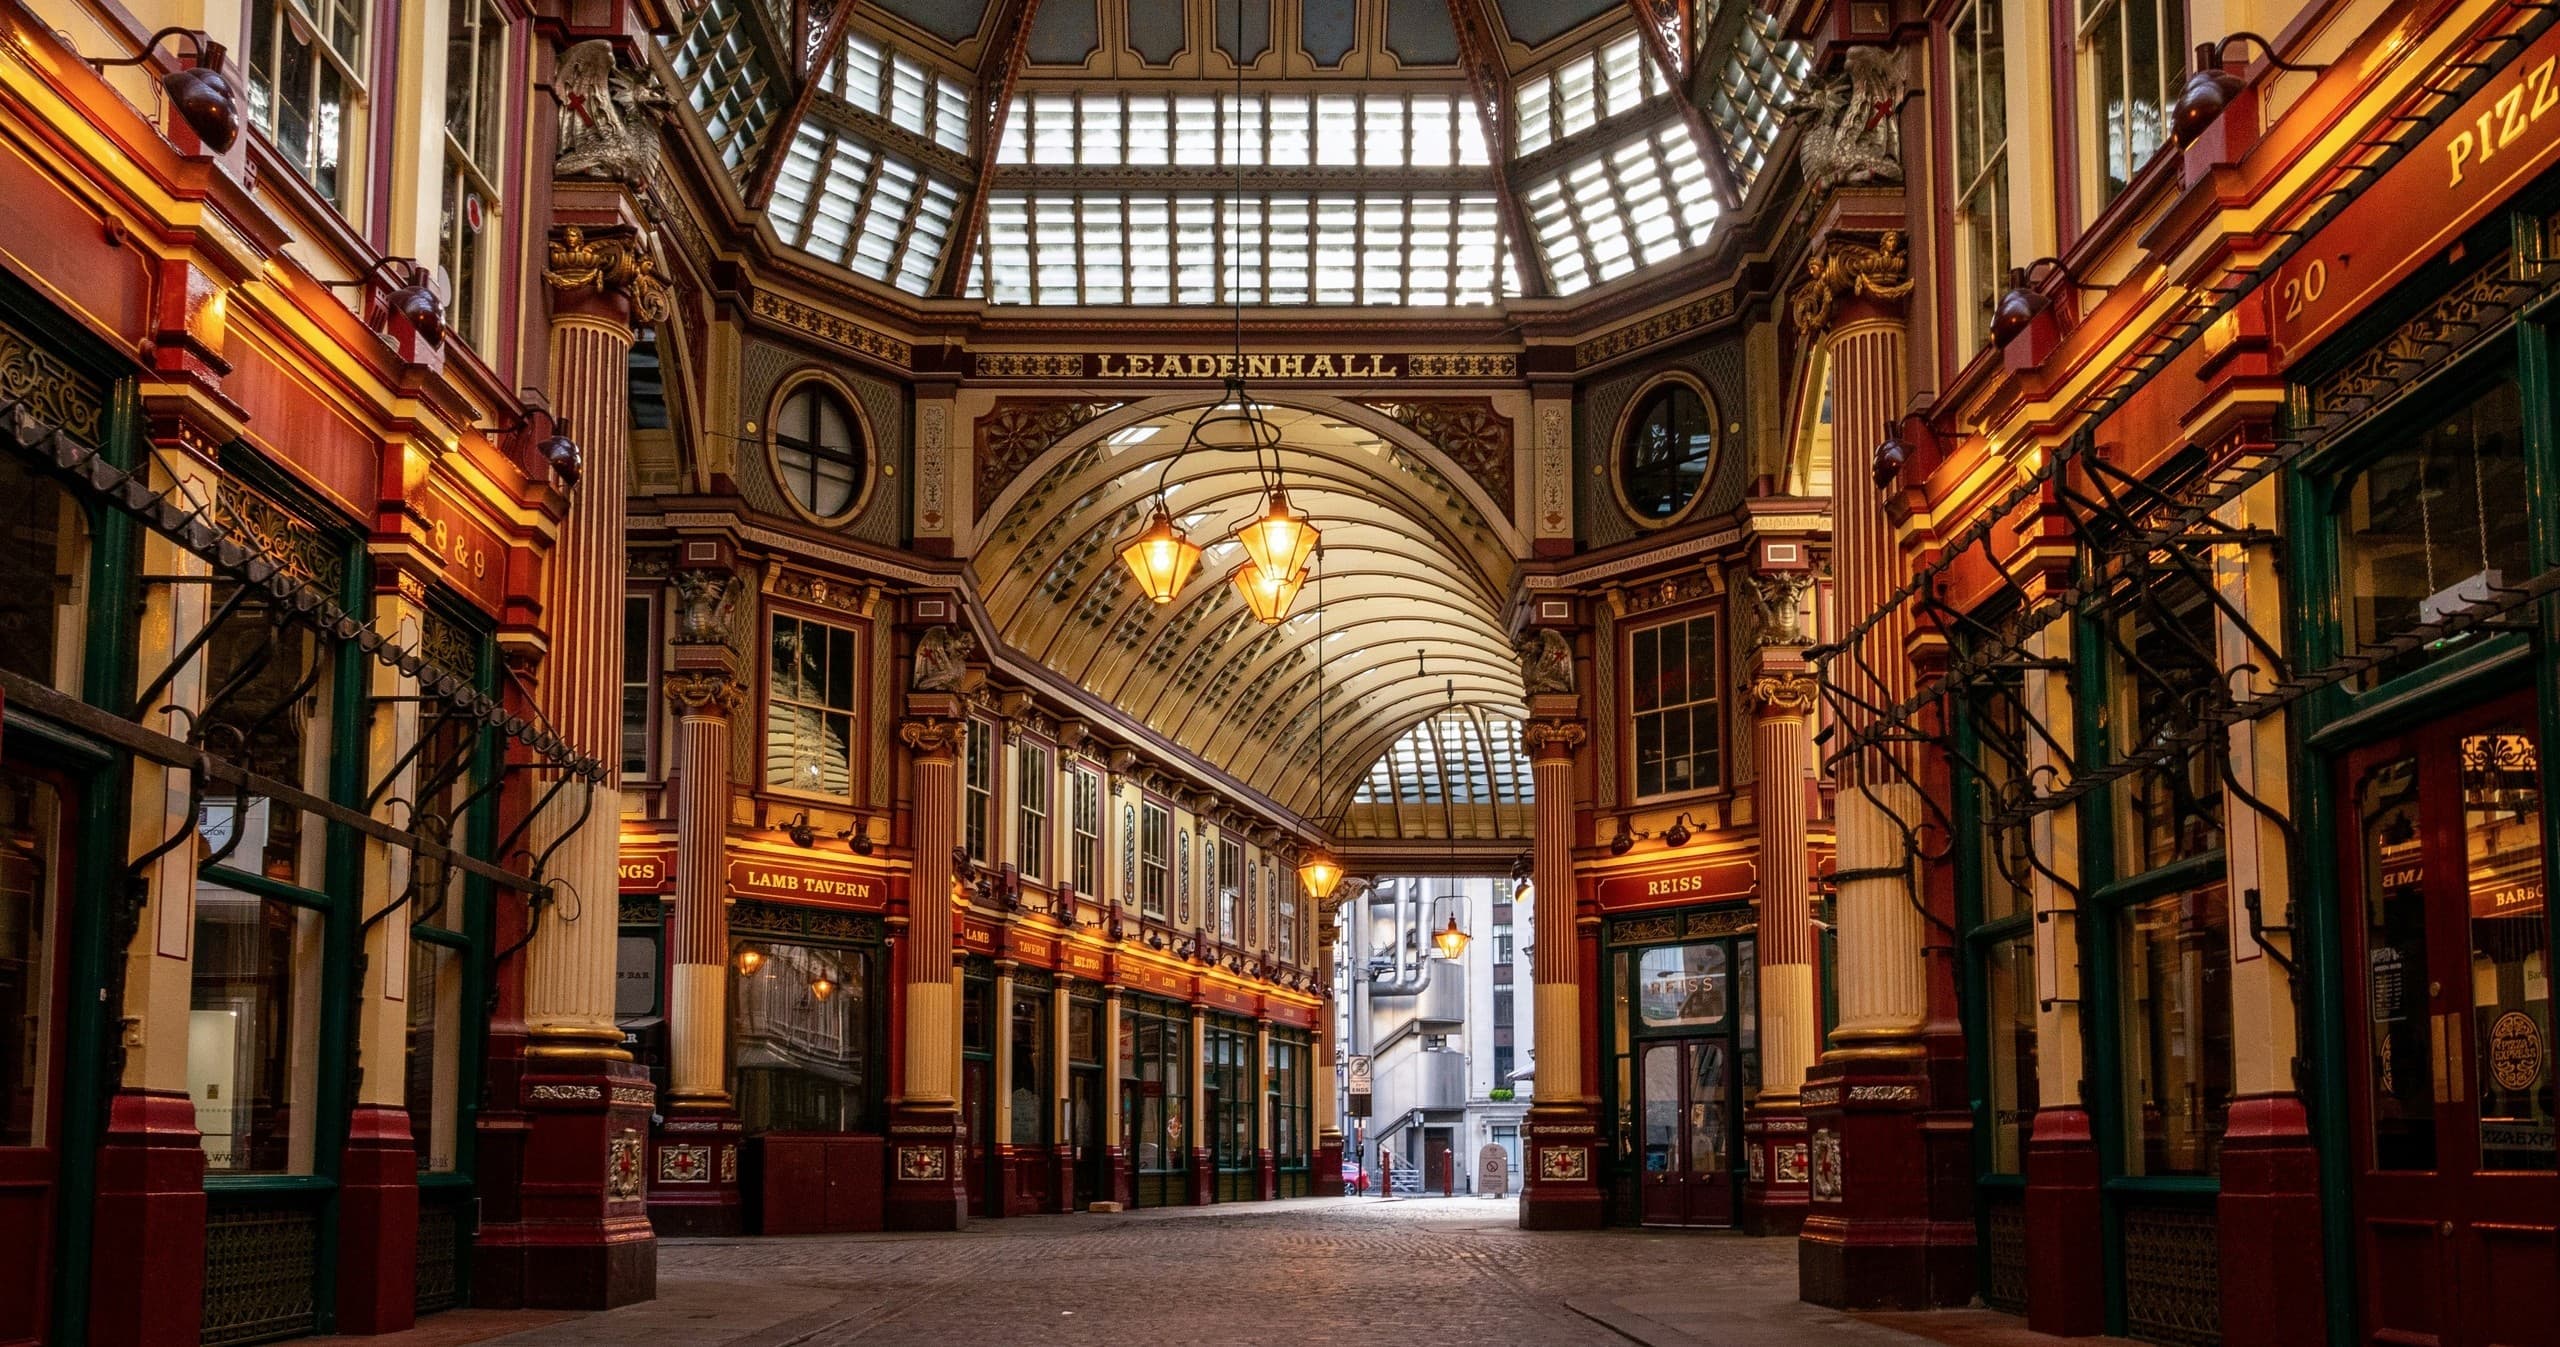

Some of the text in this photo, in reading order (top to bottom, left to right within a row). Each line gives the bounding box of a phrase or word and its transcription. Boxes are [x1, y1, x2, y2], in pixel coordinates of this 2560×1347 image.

[2284, 258, 2326, 323] 20
[1097, 354, 1397, 378] LEADENHALL
[435, 519, 485, 579] 8 & 9
[748, 871, 870, 899] LAMB TAVERN
[1648, 875, 1703, 896] REISS
[966, 928, 990, 944] LAMB
[1019, 941, 1046, 957] TAVERN
[1650, 976, 1713, 996] REISS
[2495, 1047, 2536, 1061] EXPRESS
[2501, 1038, 2528, 1050] PIZZA
